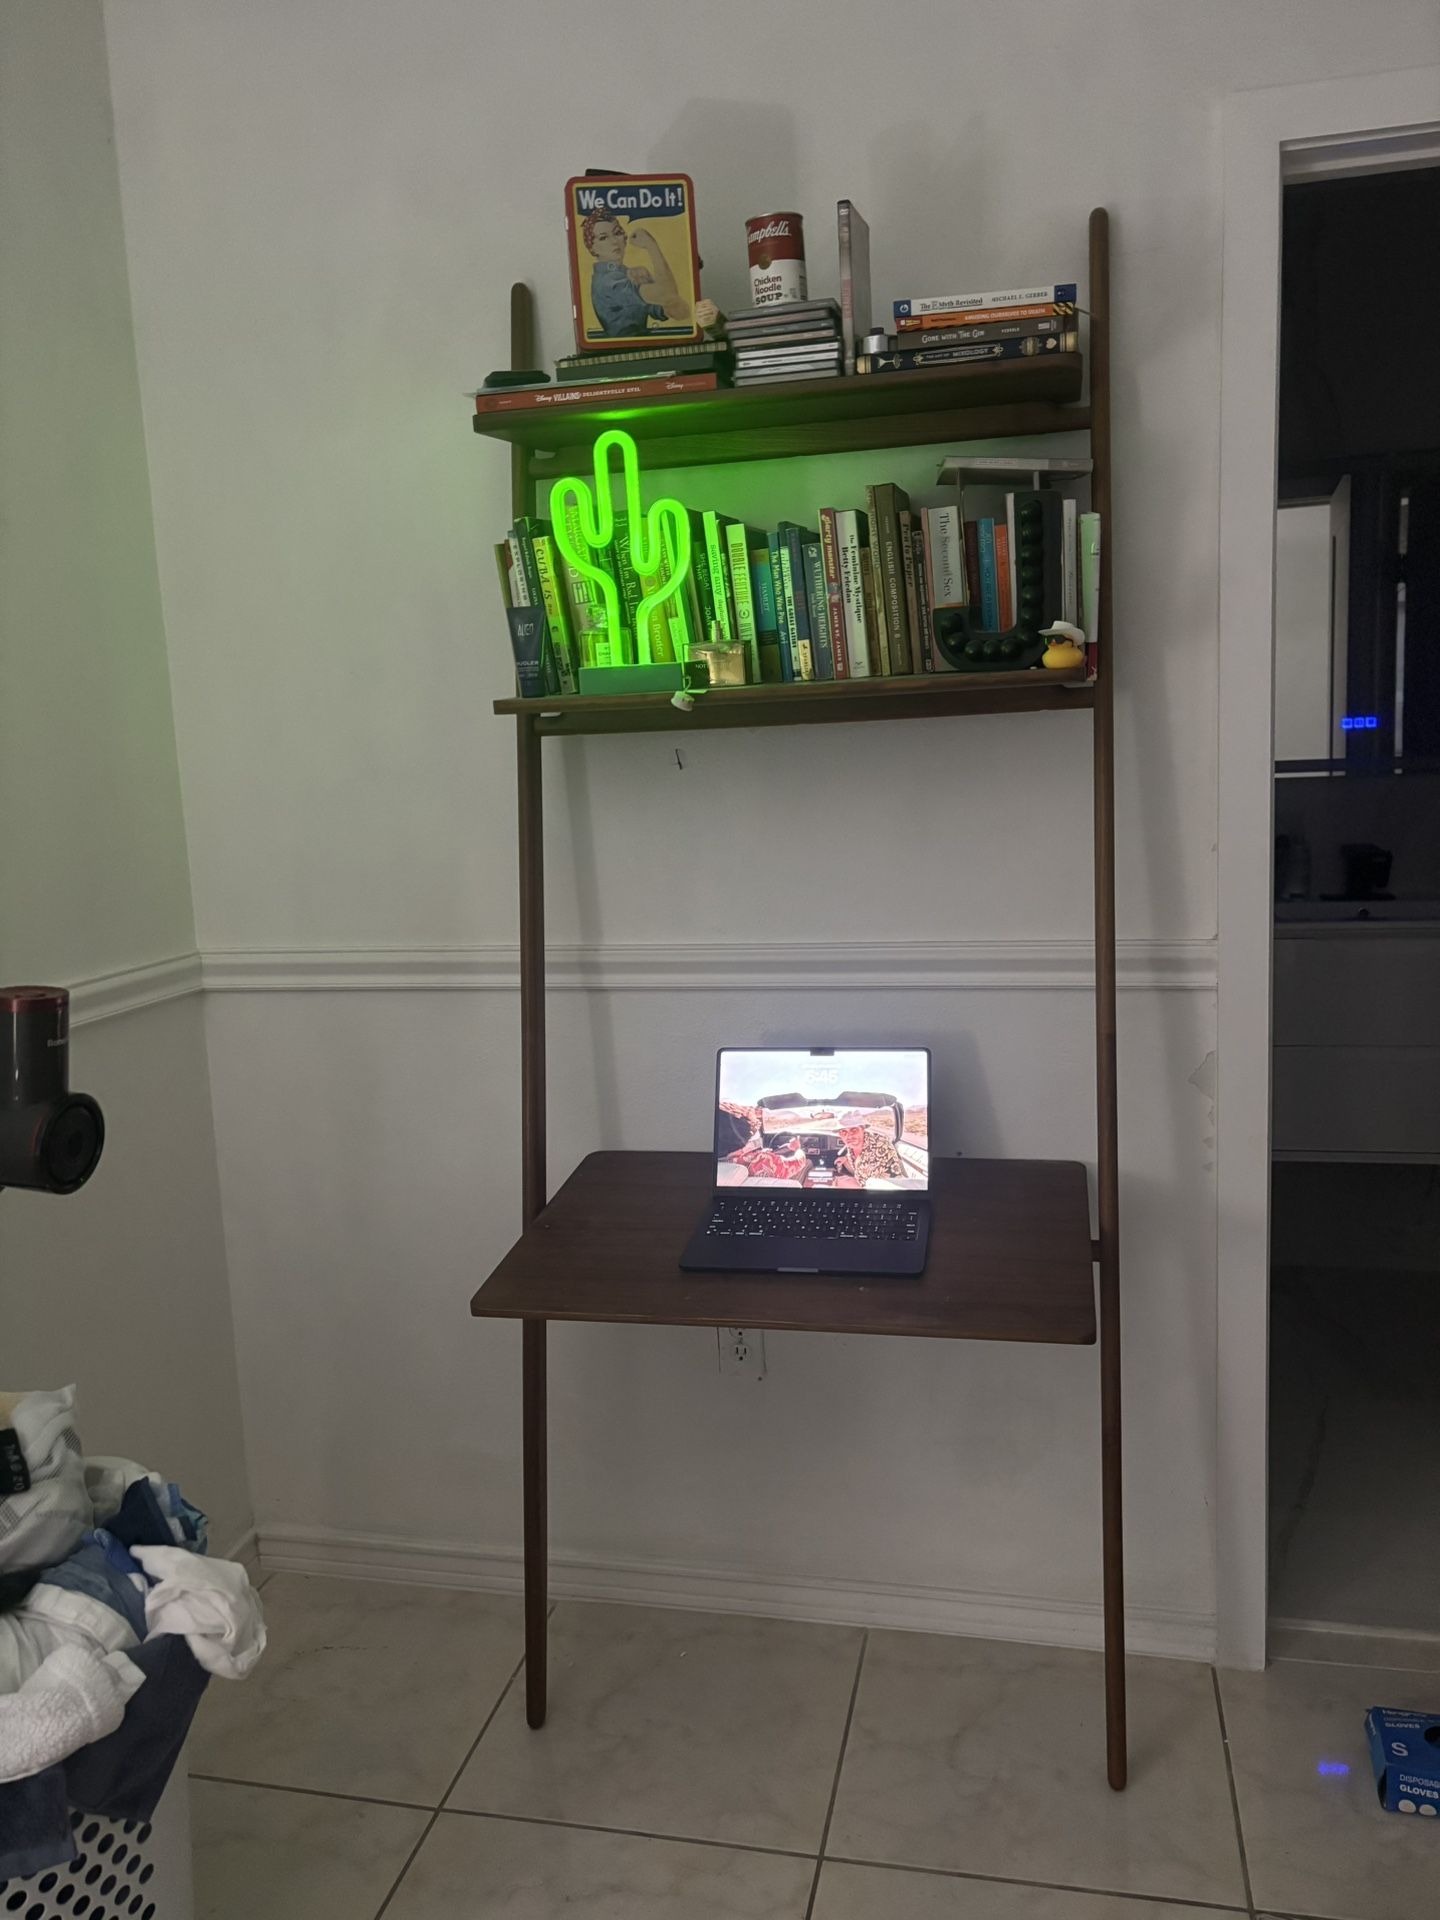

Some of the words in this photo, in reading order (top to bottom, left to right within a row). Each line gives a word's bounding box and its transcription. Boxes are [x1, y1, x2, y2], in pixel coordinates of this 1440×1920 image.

[579, 189, 605, 210] We
[607, 189, 637, 209] Can
[639, 188, 662, 208] Do
[665, 187, 683, 207] It!
[754, 275, 782, 288] Chicken
[755, 283, 782, 295] Noodle
[755, 292, 783, 305] SOUP
[920, 302, 931, 310] The
[955, 298, 983, 306] Revisited
[991, 294, 1016, 303] MICHAEL
[1025, 291, 1048, 299] GERBER
[964, 313, 990, 321] AMUSING
[990, 310, 1020, 319] OURSELVES
[1027, 307, 1046, 316] DEATH
[952, 347, 989, 357] MIXOLOGY
[534, 393, 552, 403] Disney
[553, 391, 582, 402] VILLAINS
[582, 388, 625, 398] DELIGHTFULLY
[665, 382, 684, 391] Disney
[821, 513, 834, 543] party
[902, 522, 910, 543] Pen
[938, 512, 950, 535] The
[618, 535, 632, 565] When
[709, 544, 721, 575] saving
[730, 542, 745, 570] DOUBLE
[771, 550, 779, 562] The
[840, 546, 849, 568] Betty
[886, 540, 894, 574] ENGLISH
[903, 544, 911, 555] to
[940, 535, 952, 576] Second
[772, 563, 780, 579] Man
[826, 544, 835, 579] monster
[850, 545, 859, 584] Feminine
[904, 556, 914, 588] Paper
[535, 547, 549, 583] CUBA
[543, 588, 552, 600] IS
[713, 576, 724, 596] amy
[733, 571, 748, 606] FEATURE
[774, 579, 782, 595] Who
[812, 561, 826, 611] WUTHERING
[843, 571, 852, 603] Friedan
[942, 577, 954, 598] Sex
[761, 581, 769, 613] HAMLET
[775, 595, 783, 611] Was
[852, 585, 863, 624] Mystique
[889, 577, 900, 630] COMPOSITION
[777, 611, 785, 624] Poe
[652, 622, 664, 657] Broder
[779, 630, 788, 644] Avi
[817, 613, 828, 648] HEIGHTS
[1391, 1742, 1409, 1757] S
[1399, 1784, 1439, 1799] GLOVES
